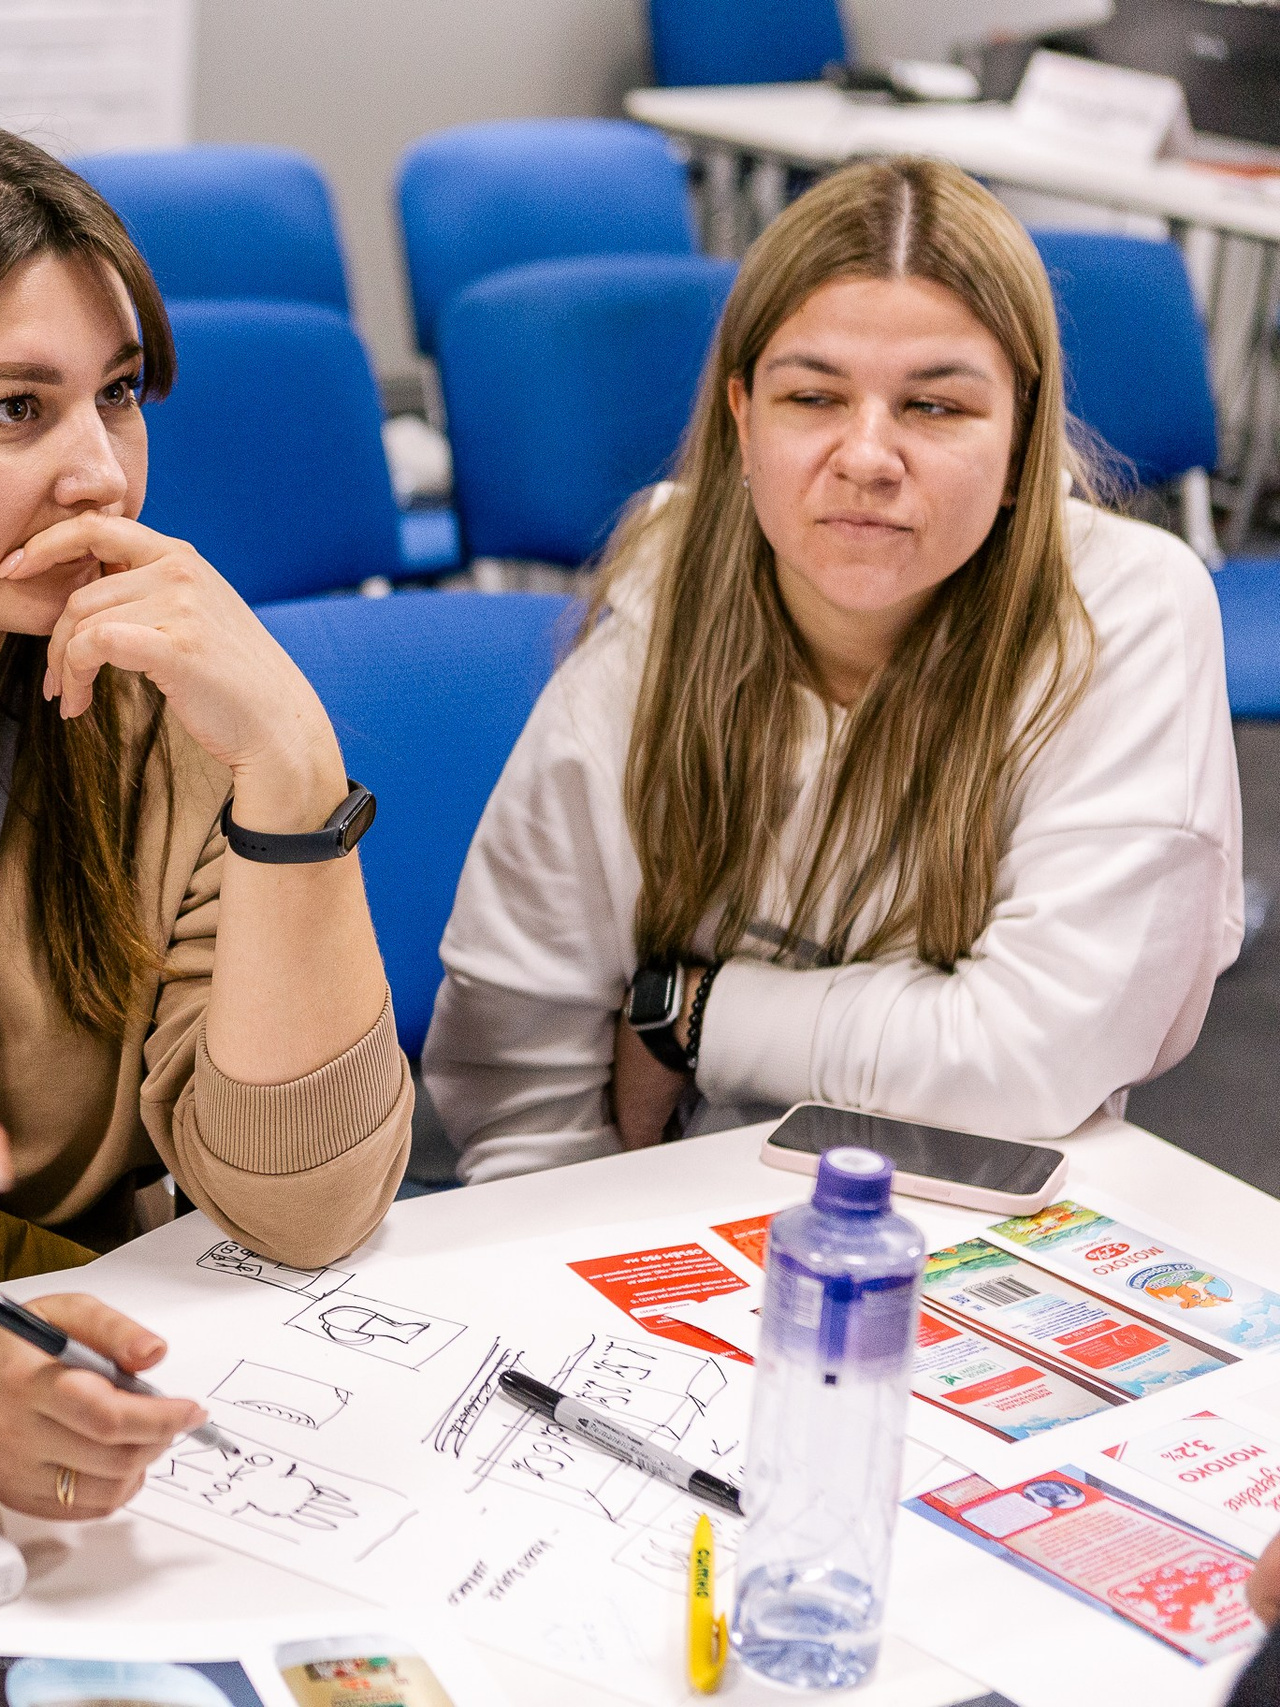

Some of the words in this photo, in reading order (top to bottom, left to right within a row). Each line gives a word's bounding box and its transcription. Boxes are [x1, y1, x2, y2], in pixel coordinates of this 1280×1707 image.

[1092, 1246, 1164, 1276] МОЛОКО
[1160, 1438, 1216, 1462] 3,2%
[1179, 1444, 1267, 1484] МОЛОКО
